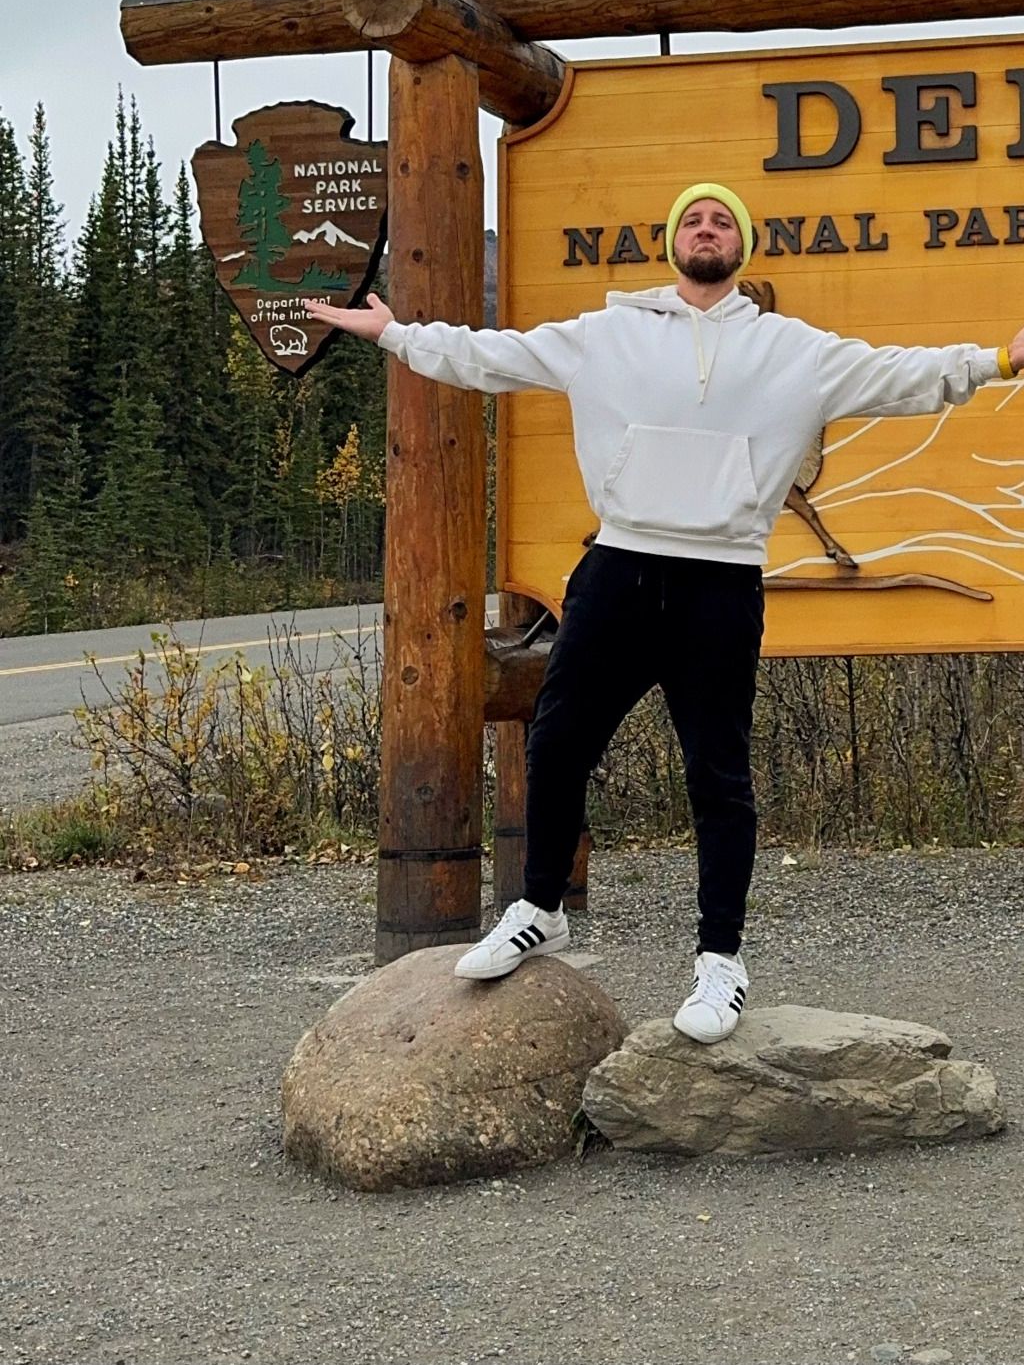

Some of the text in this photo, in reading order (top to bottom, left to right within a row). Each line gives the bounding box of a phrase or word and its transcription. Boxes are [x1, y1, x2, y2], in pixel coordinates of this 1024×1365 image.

[294, 159, 382, 177] NATIONAL
[316, 179, 362, 194] PARK
[302, 196, 377, 214] SERVICE
[563, 212, 888, 266] NANAL
[250, 310, 264, 323] of
[266, 310, 286, 322] the
